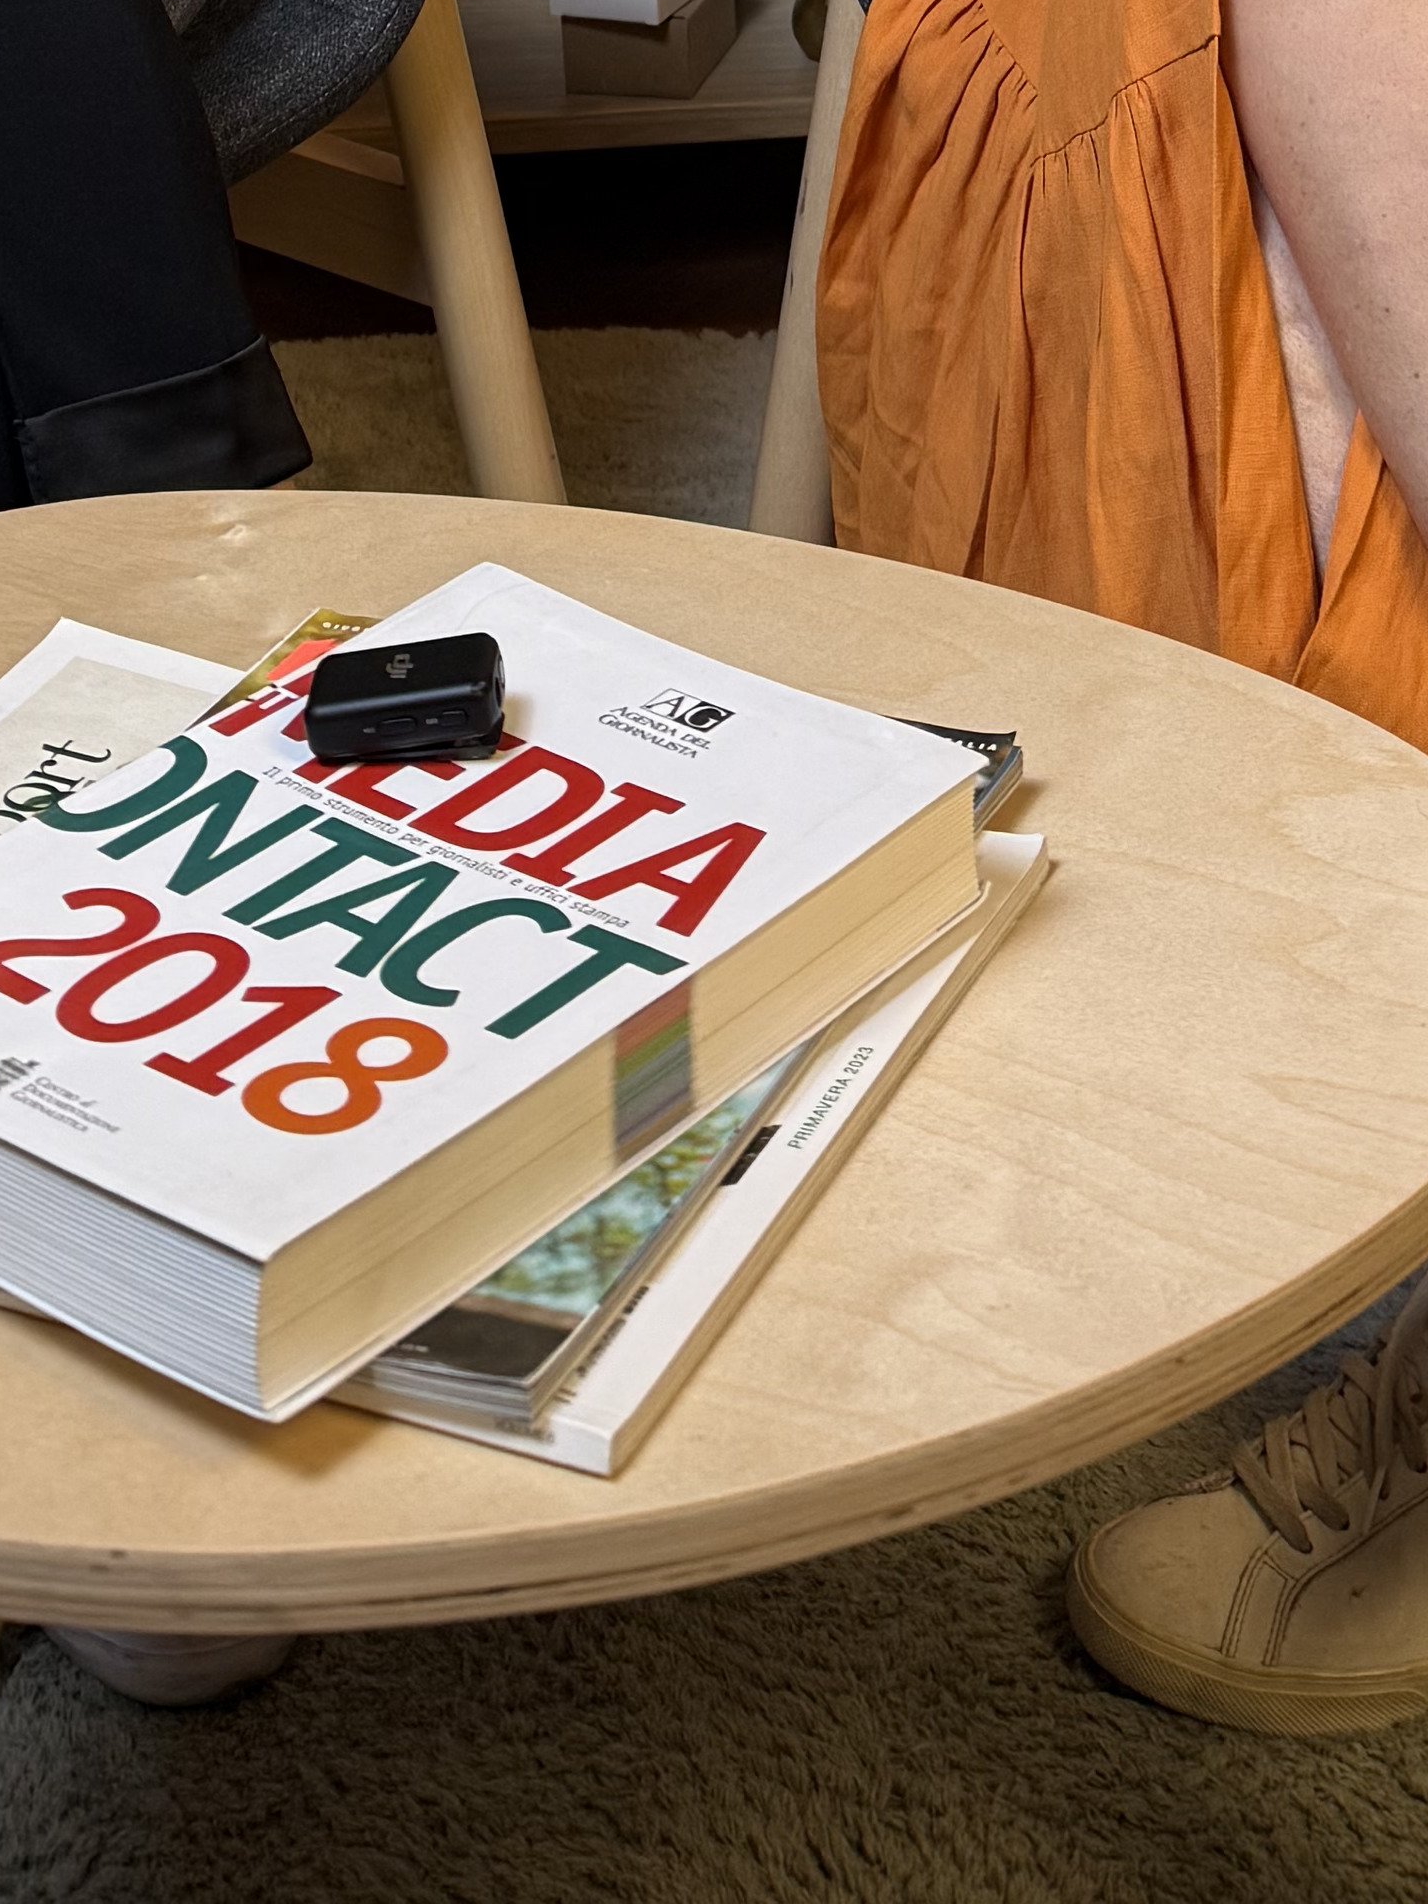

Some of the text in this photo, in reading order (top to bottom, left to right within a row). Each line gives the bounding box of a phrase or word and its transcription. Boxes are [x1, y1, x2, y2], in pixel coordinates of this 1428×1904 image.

[598, 713, 698, 760] GIORNALISTA
[609, 705, 711, 751] AGENDA DEL
[262, 766, 630, 930] Il primo strumento per giornalisti e uffici stampa
[9, 1089, 90, 1133] GIORNALISTICA
[22, 1082, 122, 1134] DOCUMENTAZIONE
[33, 1076, 81, 1102] CENTRO
[787, 1045, 875, 1151] PRIMAVERA 2023
